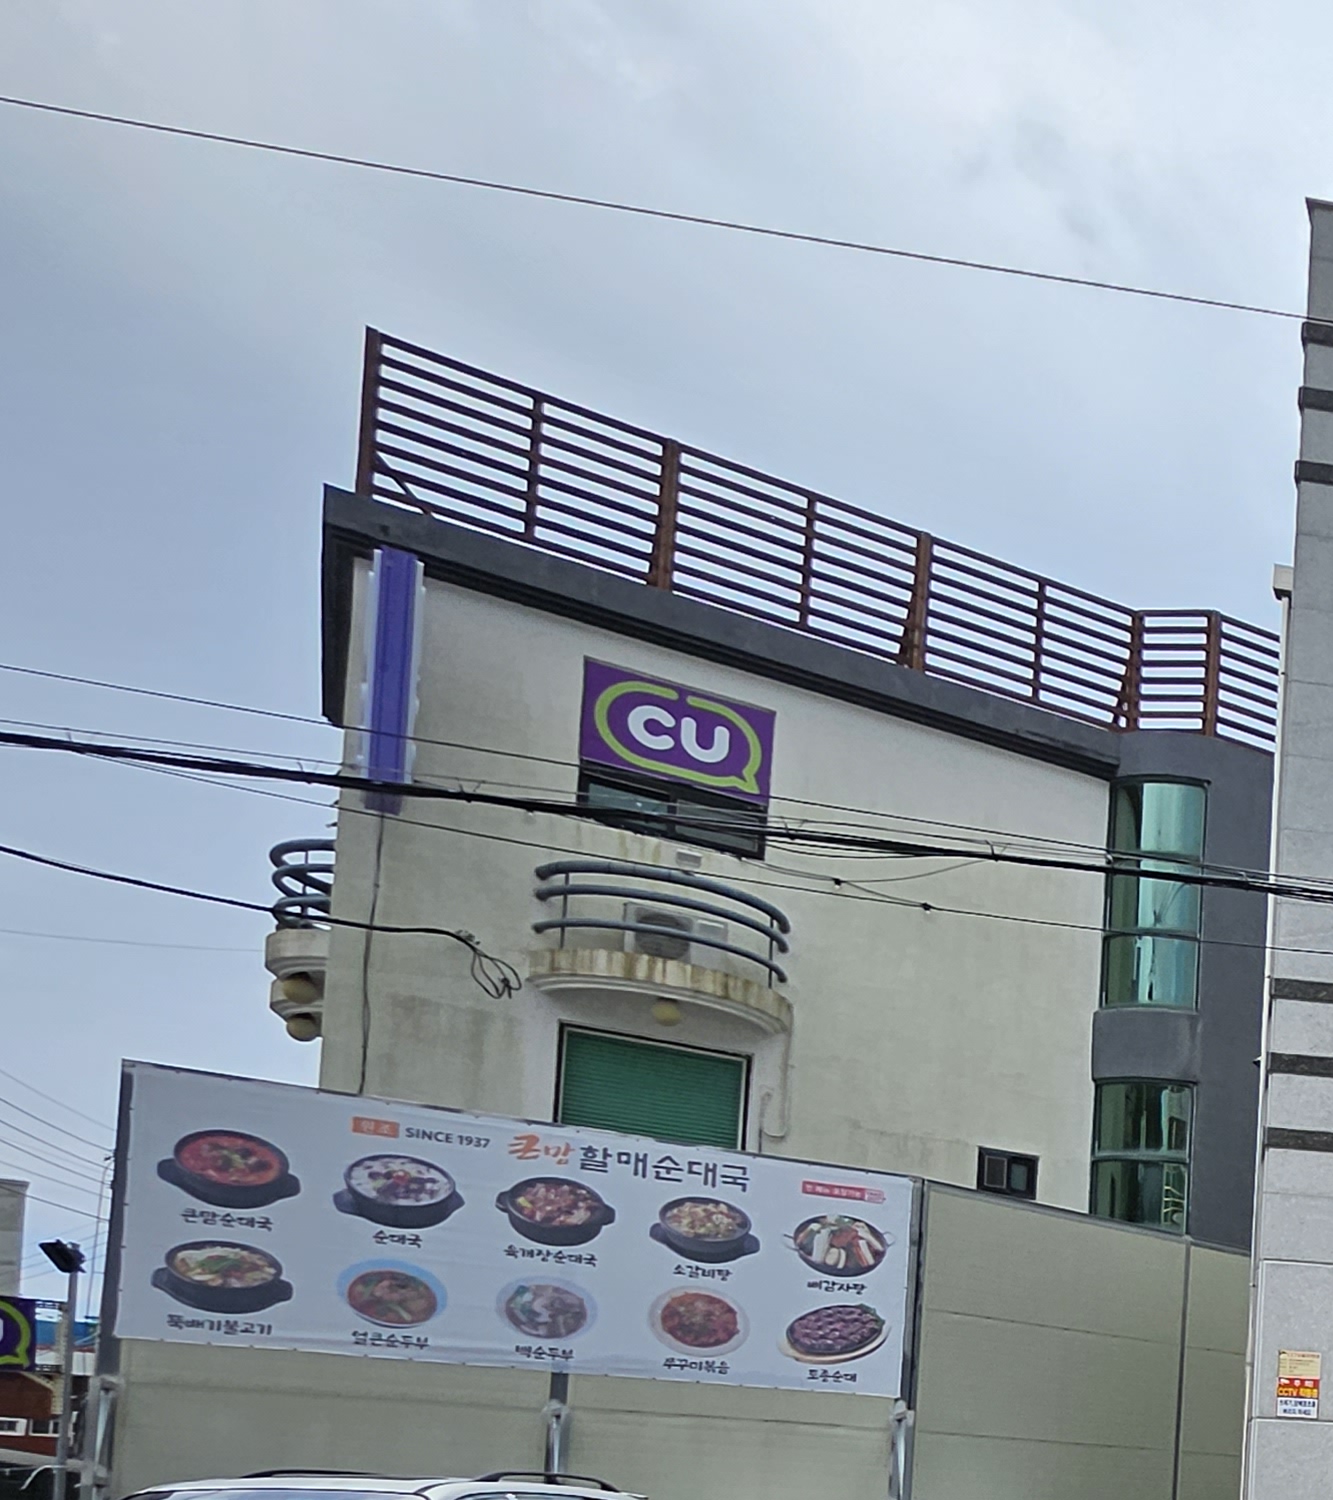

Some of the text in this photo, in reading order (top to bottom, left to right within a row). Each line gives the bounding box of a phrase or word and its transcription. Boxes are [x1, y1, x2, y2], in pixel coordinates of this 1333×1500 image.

[627, 705, 730, 763] CU
[405, 1127, 454, 1144] SINCE
[457, 1134, 491, 1149] 1937
[580, 1143, 751, 1193] 할매순대국
[181, 1208, 274, 1232] 큰맘순대국
[373, 1231, 423, 1248] 순대국
[673, 1264, 733, 1281] 소갈비탕
[166, 1313, 273, 1336] 뚝배기불고기
[352, 1330, 430, 1350] 얼큰순두부
[515, 1345, 575, 1361] 백순두부
[807, 1368, 858, 1383] 토종순대
